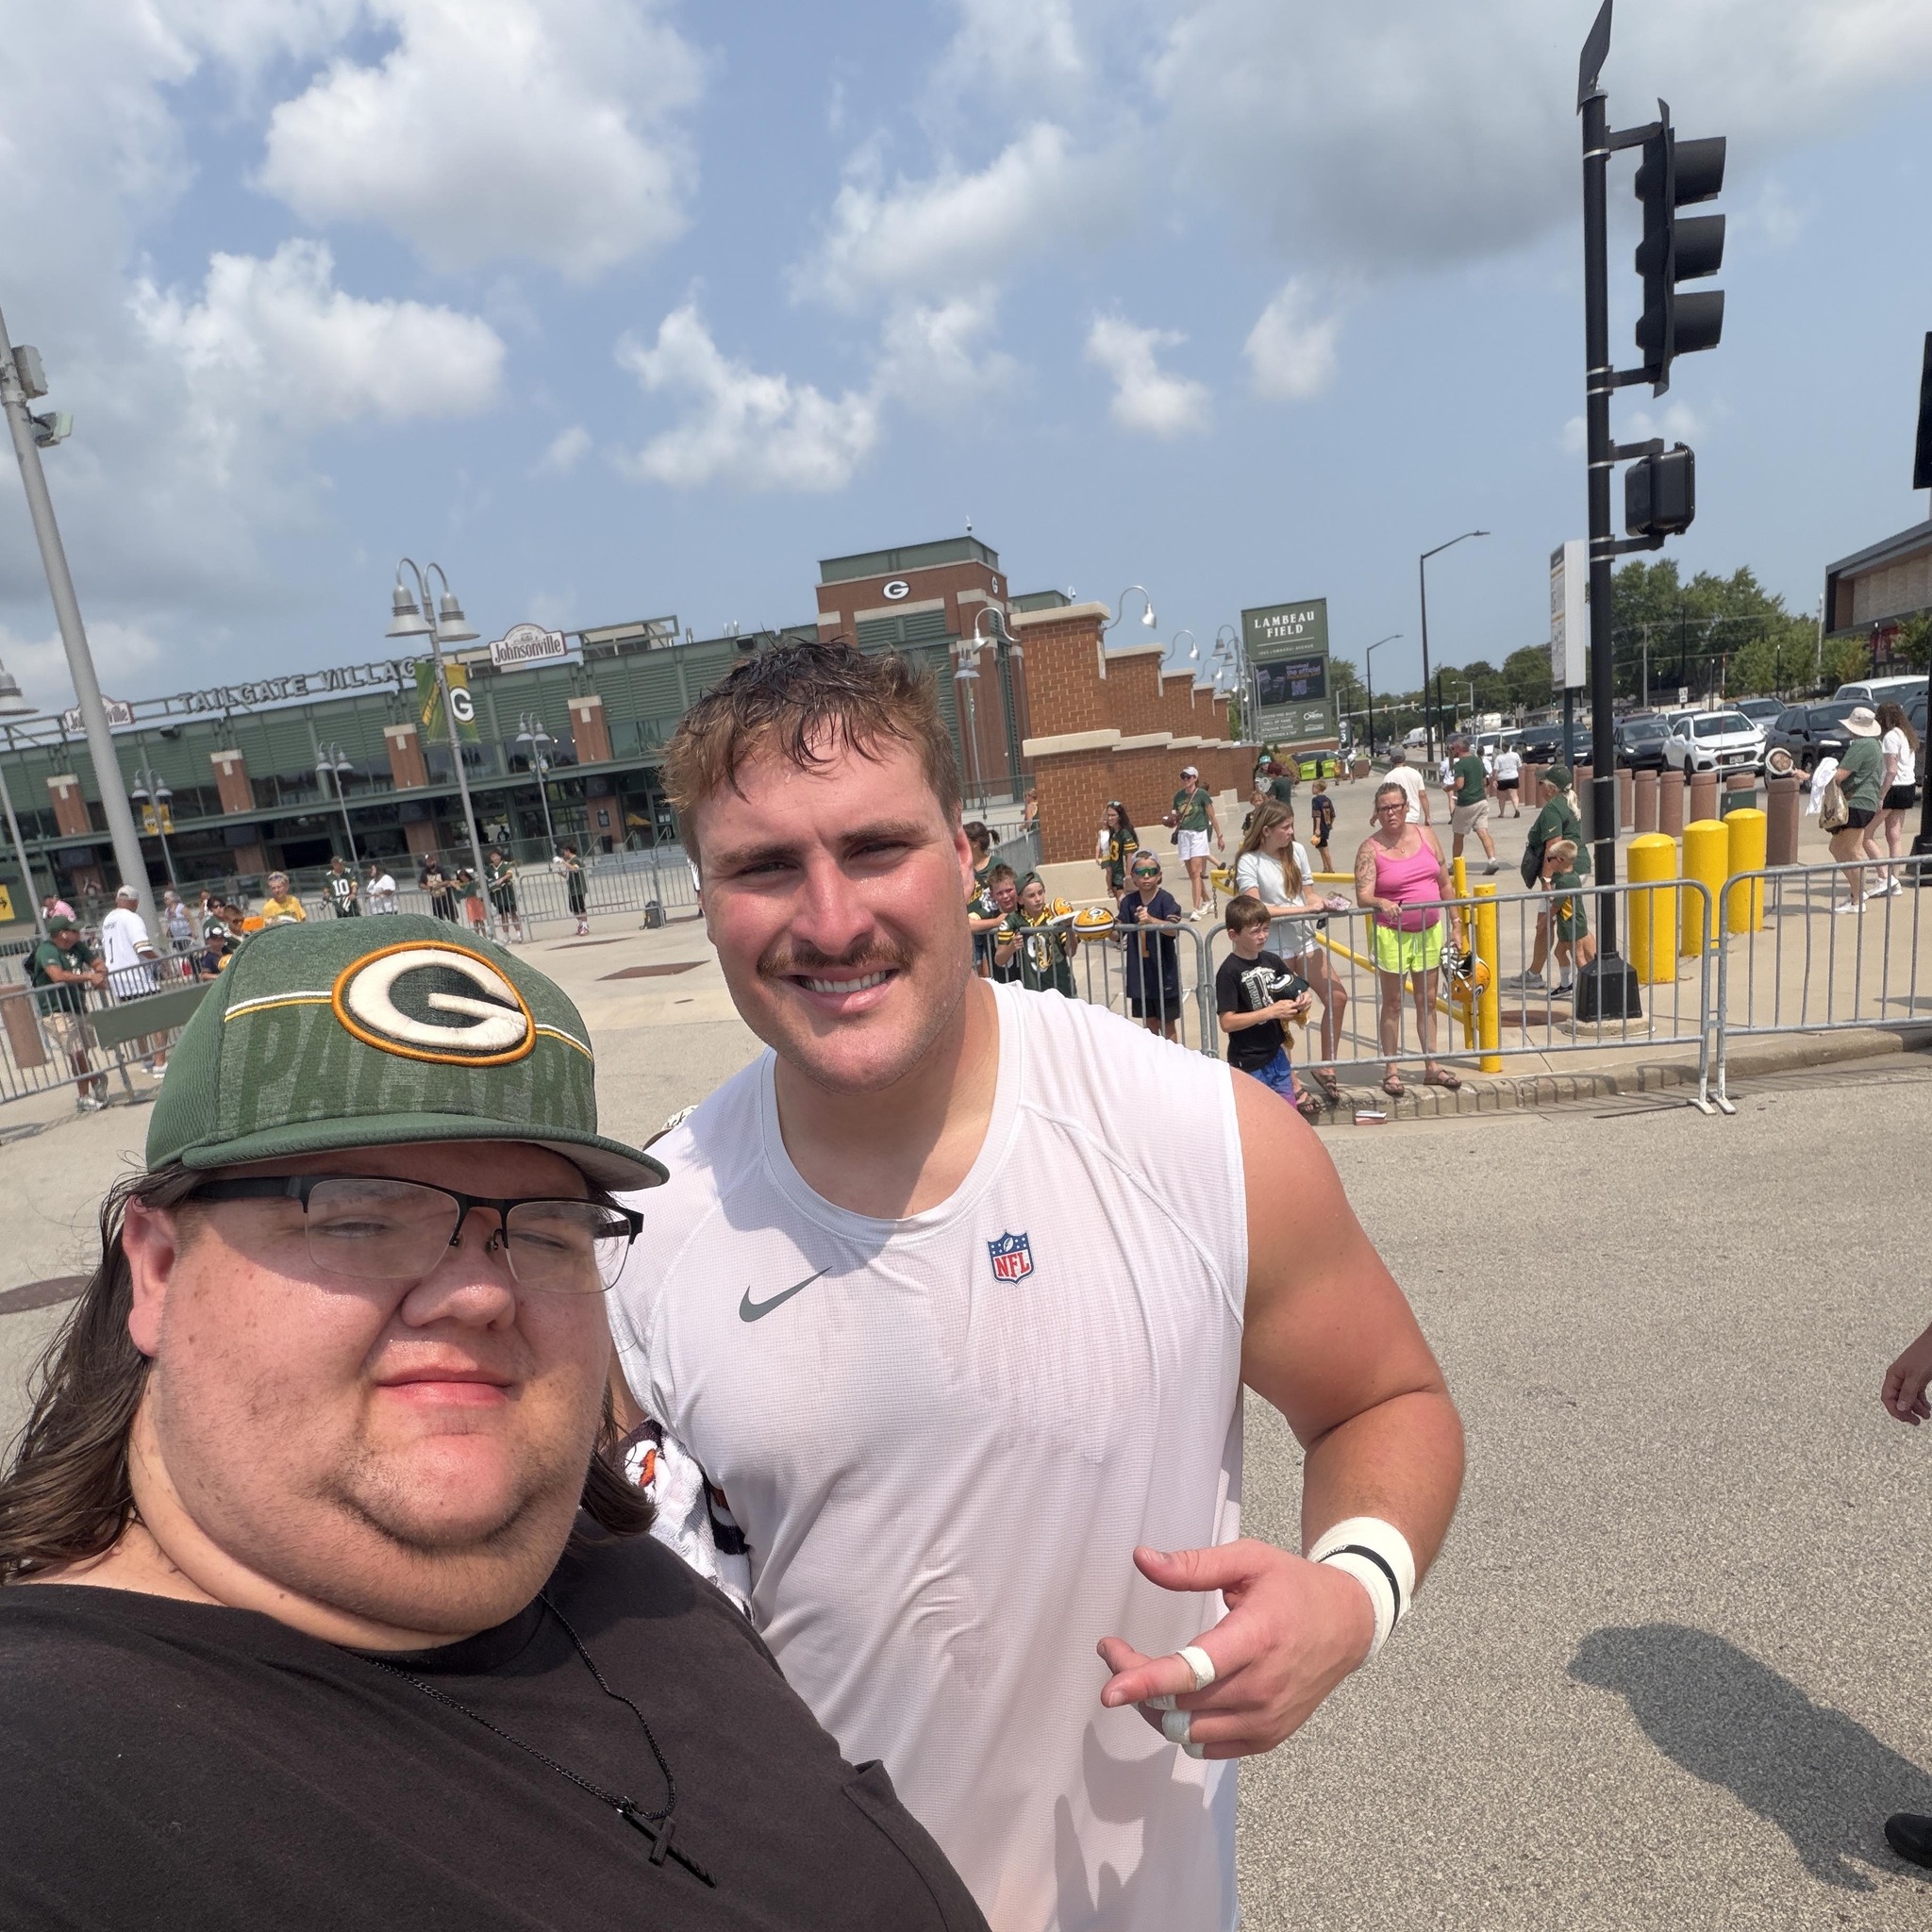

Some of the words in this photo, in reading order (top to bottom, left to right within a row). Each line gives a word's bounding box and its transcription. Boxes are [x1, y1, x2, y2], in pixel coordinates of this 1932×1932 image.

[1254, 611, 1315, 629] LAMBEAU
[1267, 625, 1304, 639] FIELD
[494, 635, 562, 663] Johnsonville
[177, 675, 308, 713] TAILGATE
[449, 687, 475, 722] G
[1341, 733, 1347, 742] 3
[332, 878, 350, 897] 10
[348, 948, 527, 1051] G
[994, 1251, 1031, 1278] NFL
